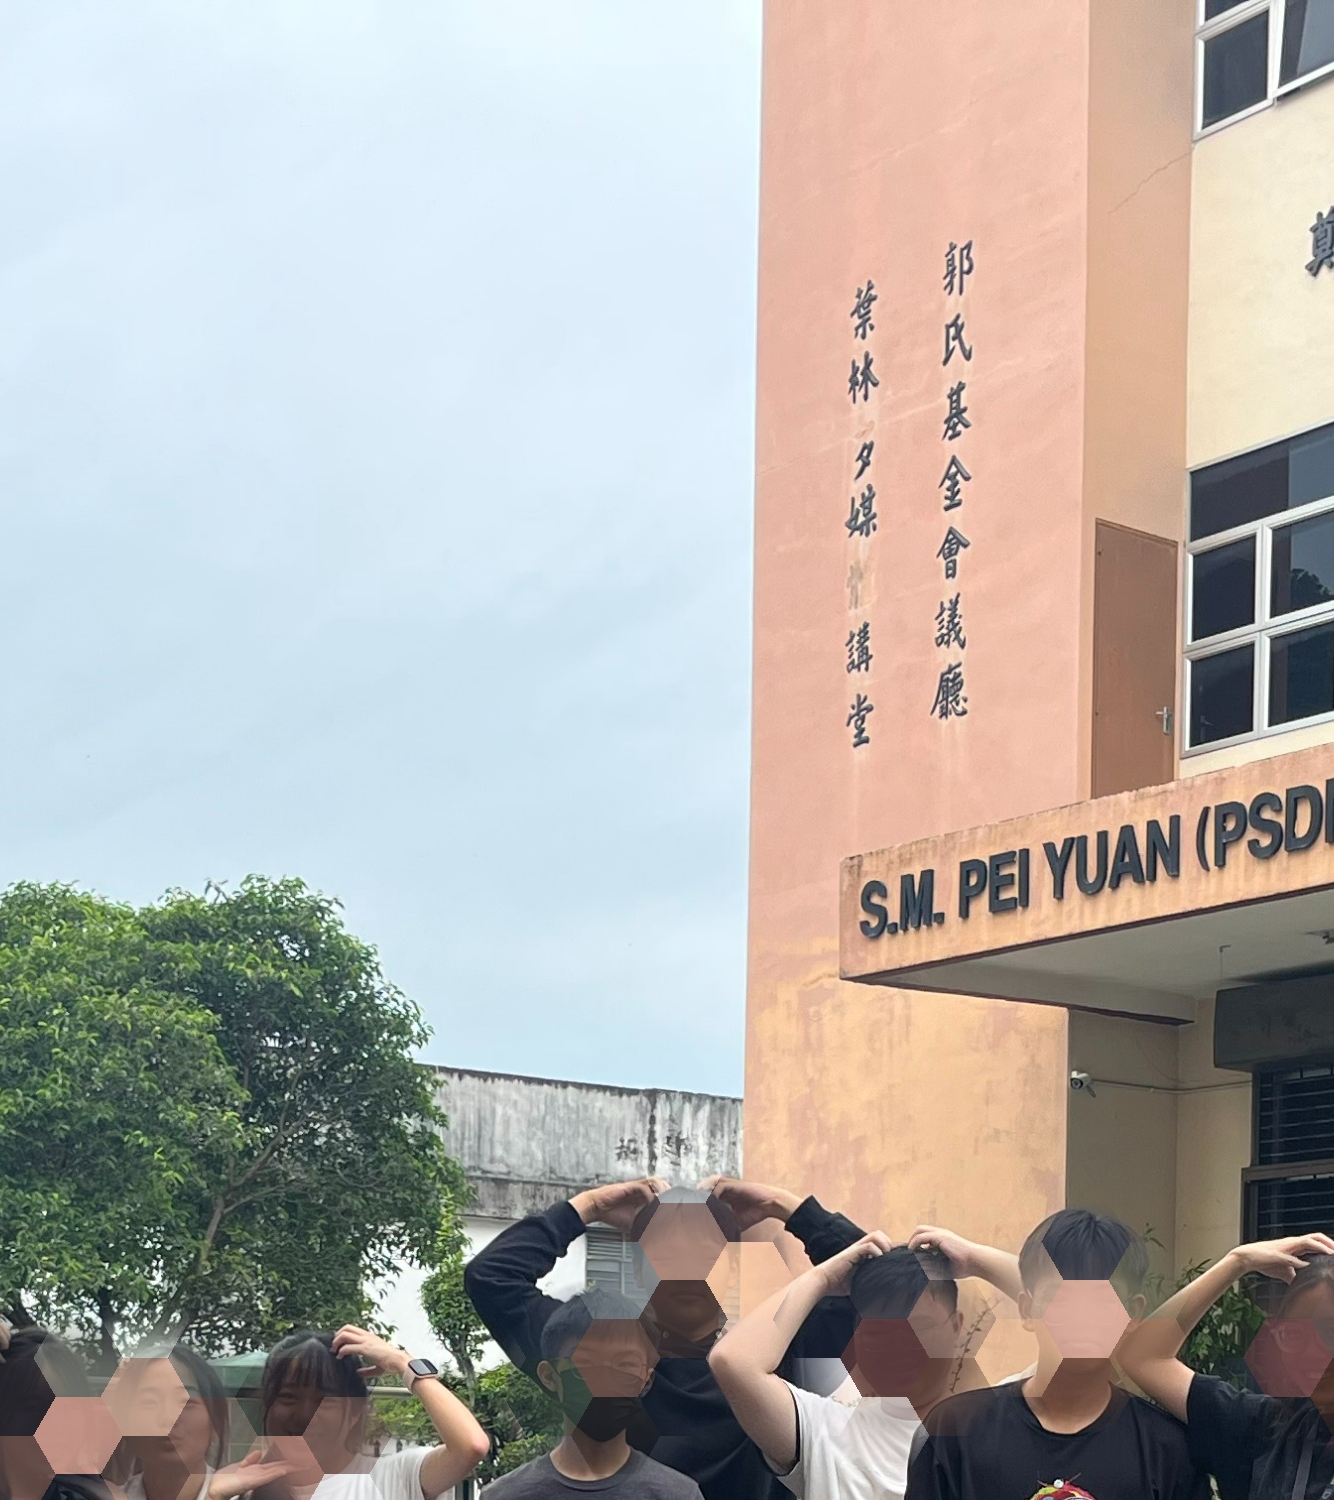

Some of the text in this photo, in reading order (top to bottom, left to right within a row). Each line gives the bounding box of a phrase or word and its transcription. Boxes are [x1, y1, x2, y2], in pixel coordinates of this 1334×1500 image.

[930, 239, 973, 720] 郭氏基金會議廳
[859, 868, 945, 939] S.M.
[958, 848, 1030, 920] PEI
[1042, 814, 1181, 901] YUAN
